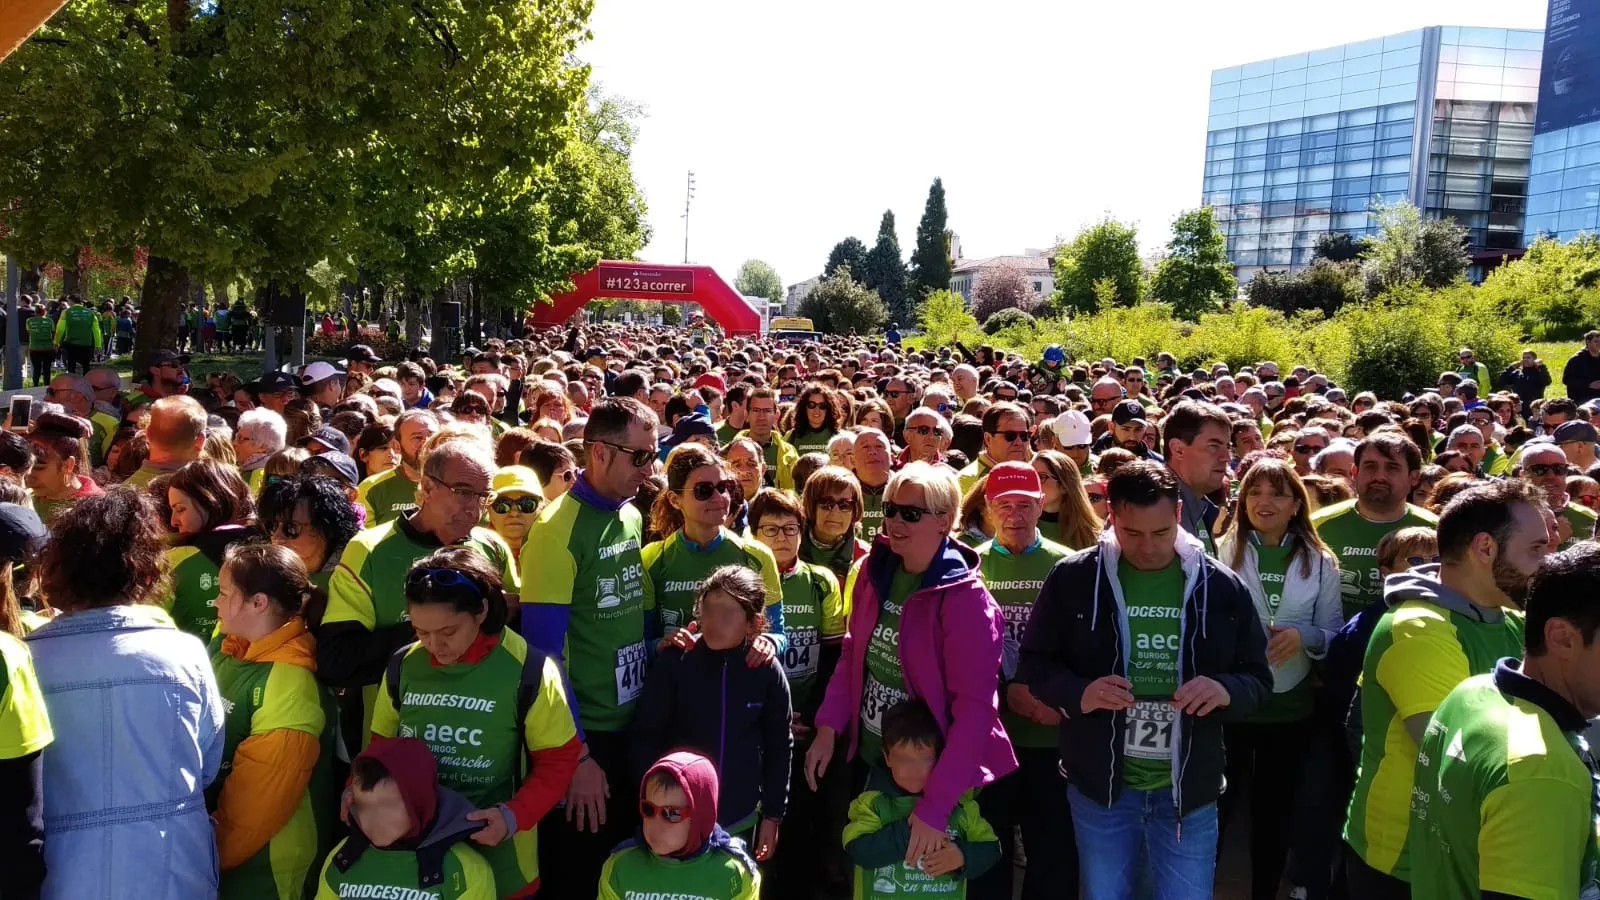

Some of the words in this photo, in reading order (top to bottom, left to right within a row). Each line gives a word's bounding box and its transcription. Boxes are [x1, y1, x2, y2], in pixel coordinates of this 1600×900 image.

[622, 562, 643, 582] aec
[986, 580, 1045, 590] BRIDGESTO
[782, 604, 815, 614] ESTONE
[787, 630, 818, 639] TACIÓN
[873, 623, 899, 646] aec
[1136, 633, 1179, 650] aec
[403, 691, 497, 713] BRIDGESTONE
[423, 723, 483, 746] aecc
[440, 755, 495, 769] marcha
